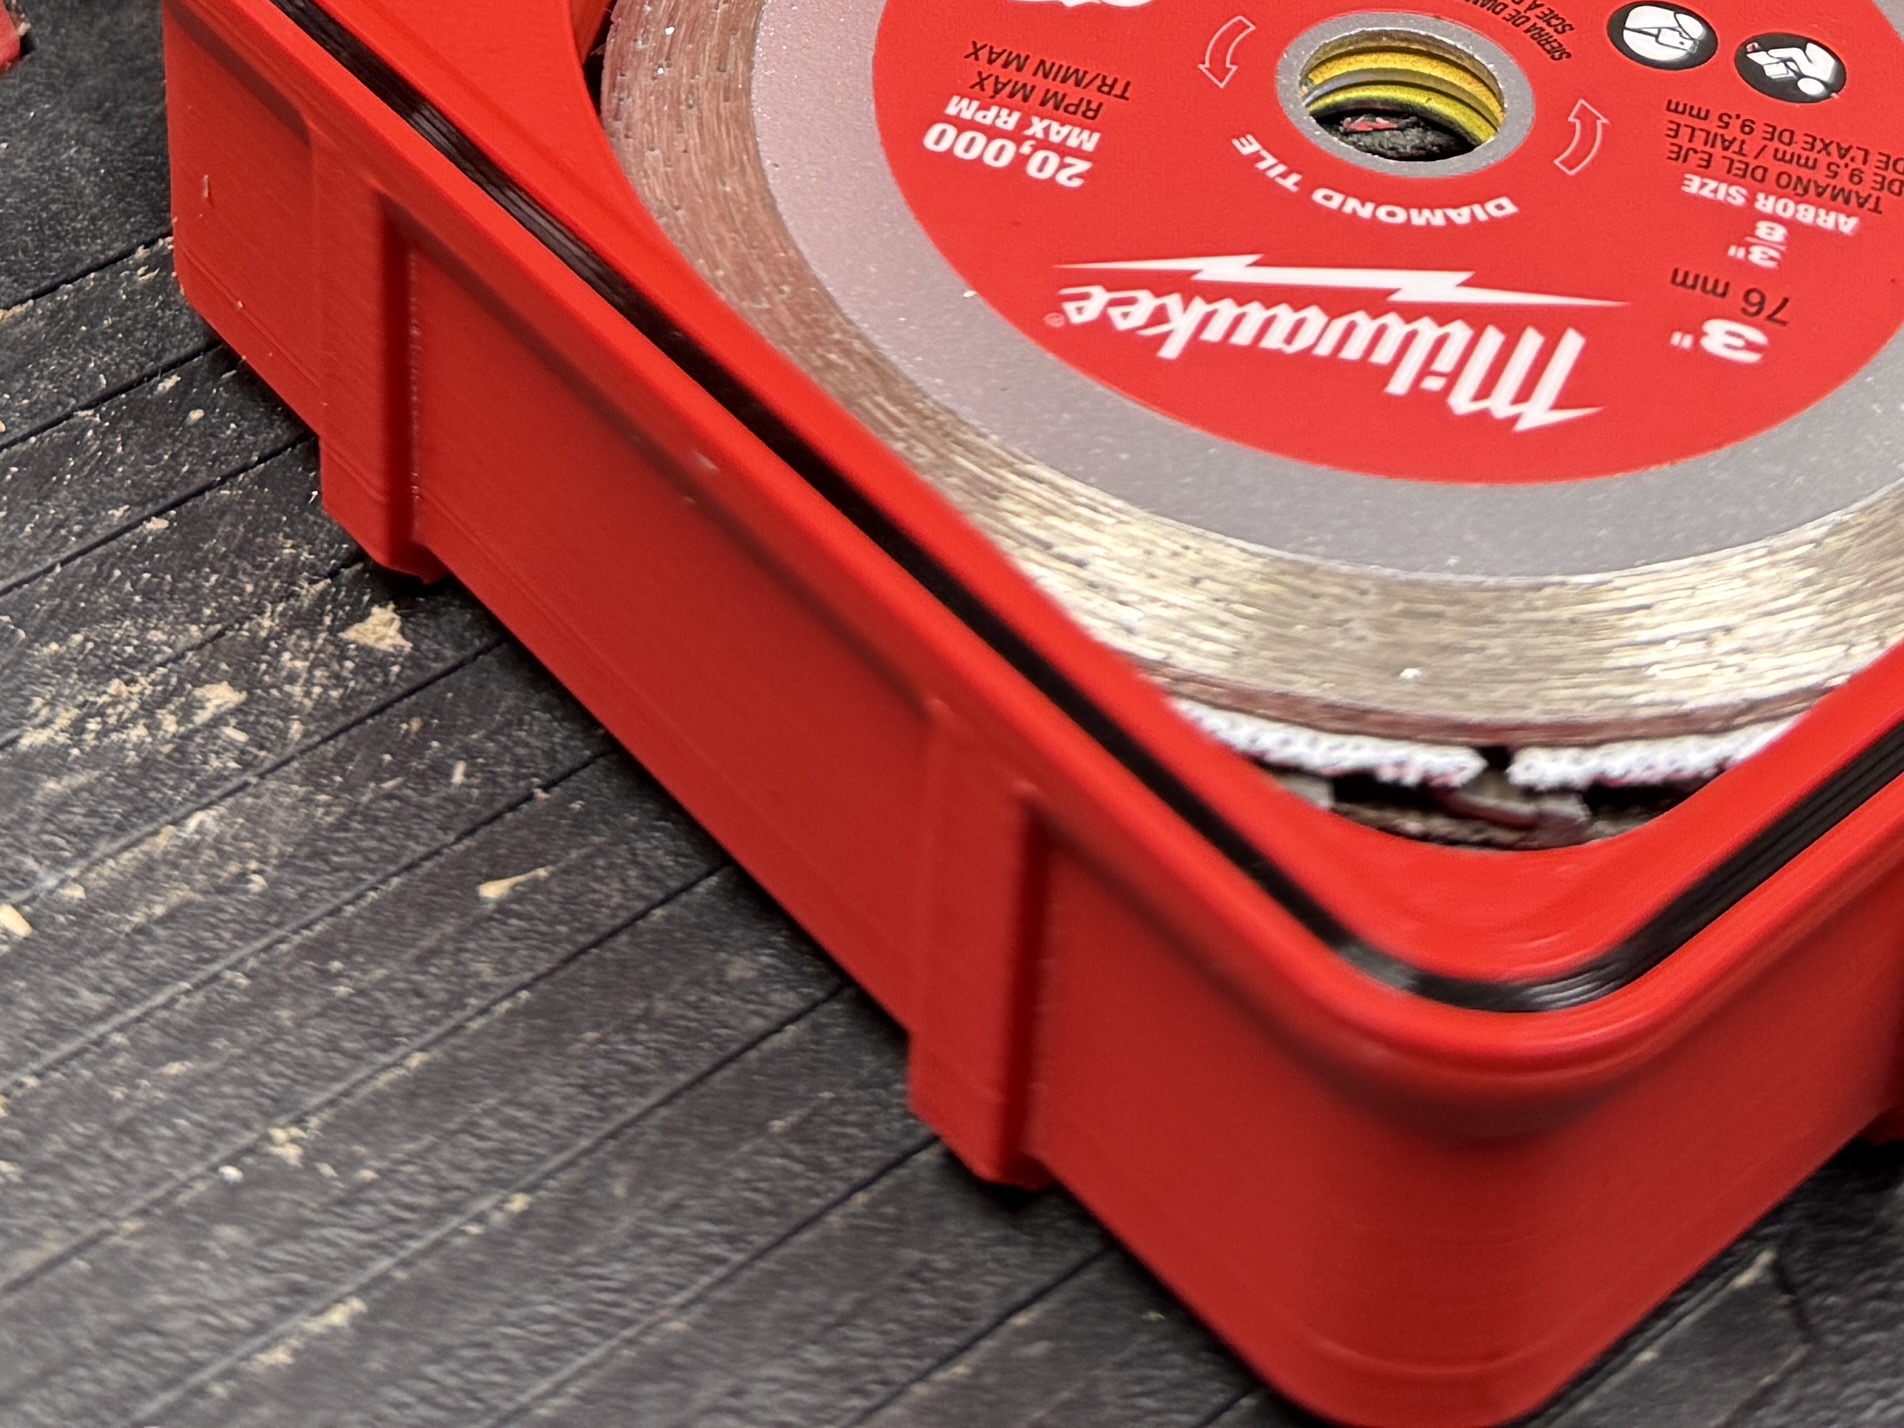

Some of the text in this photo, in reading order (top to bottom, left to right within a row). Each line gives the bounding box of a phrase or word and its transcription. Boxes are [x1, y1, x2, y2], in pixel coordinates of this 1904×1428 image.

[1504, 8, 1532, 28] DE
[1537, 7, 1575, 36] SCIE
[1524, 22, 1572, 62] SIERRA
[963, 40, 1133, 101] TR/MIN MAX
[969, 70, 1104, 121] RPM MÁX
[1665, 99, 1711, 122] mm
[944, 95, 1102, 153] MAX RPM
[1665, 121, 1748, 157] TAILLE
[1761, 122, 1796, 147] DE
[922, 122, 1093, 188] 20,000
[1753, 145, 1768, 160] /
[1772, 148, 1818, 171] mm
[1231, 133, 1519, 227] DIAMOND TILE
[1665, 142, 1883, 214] TAMAÑO DEL EJE
[1871, 172, 1904, 197] DE
[1681, 173, 1860, 236] ARBOR SIZE
[1670, 267, 1790, 327] 76 mm
[1059, 285, 1605, 432] Milwaukee
